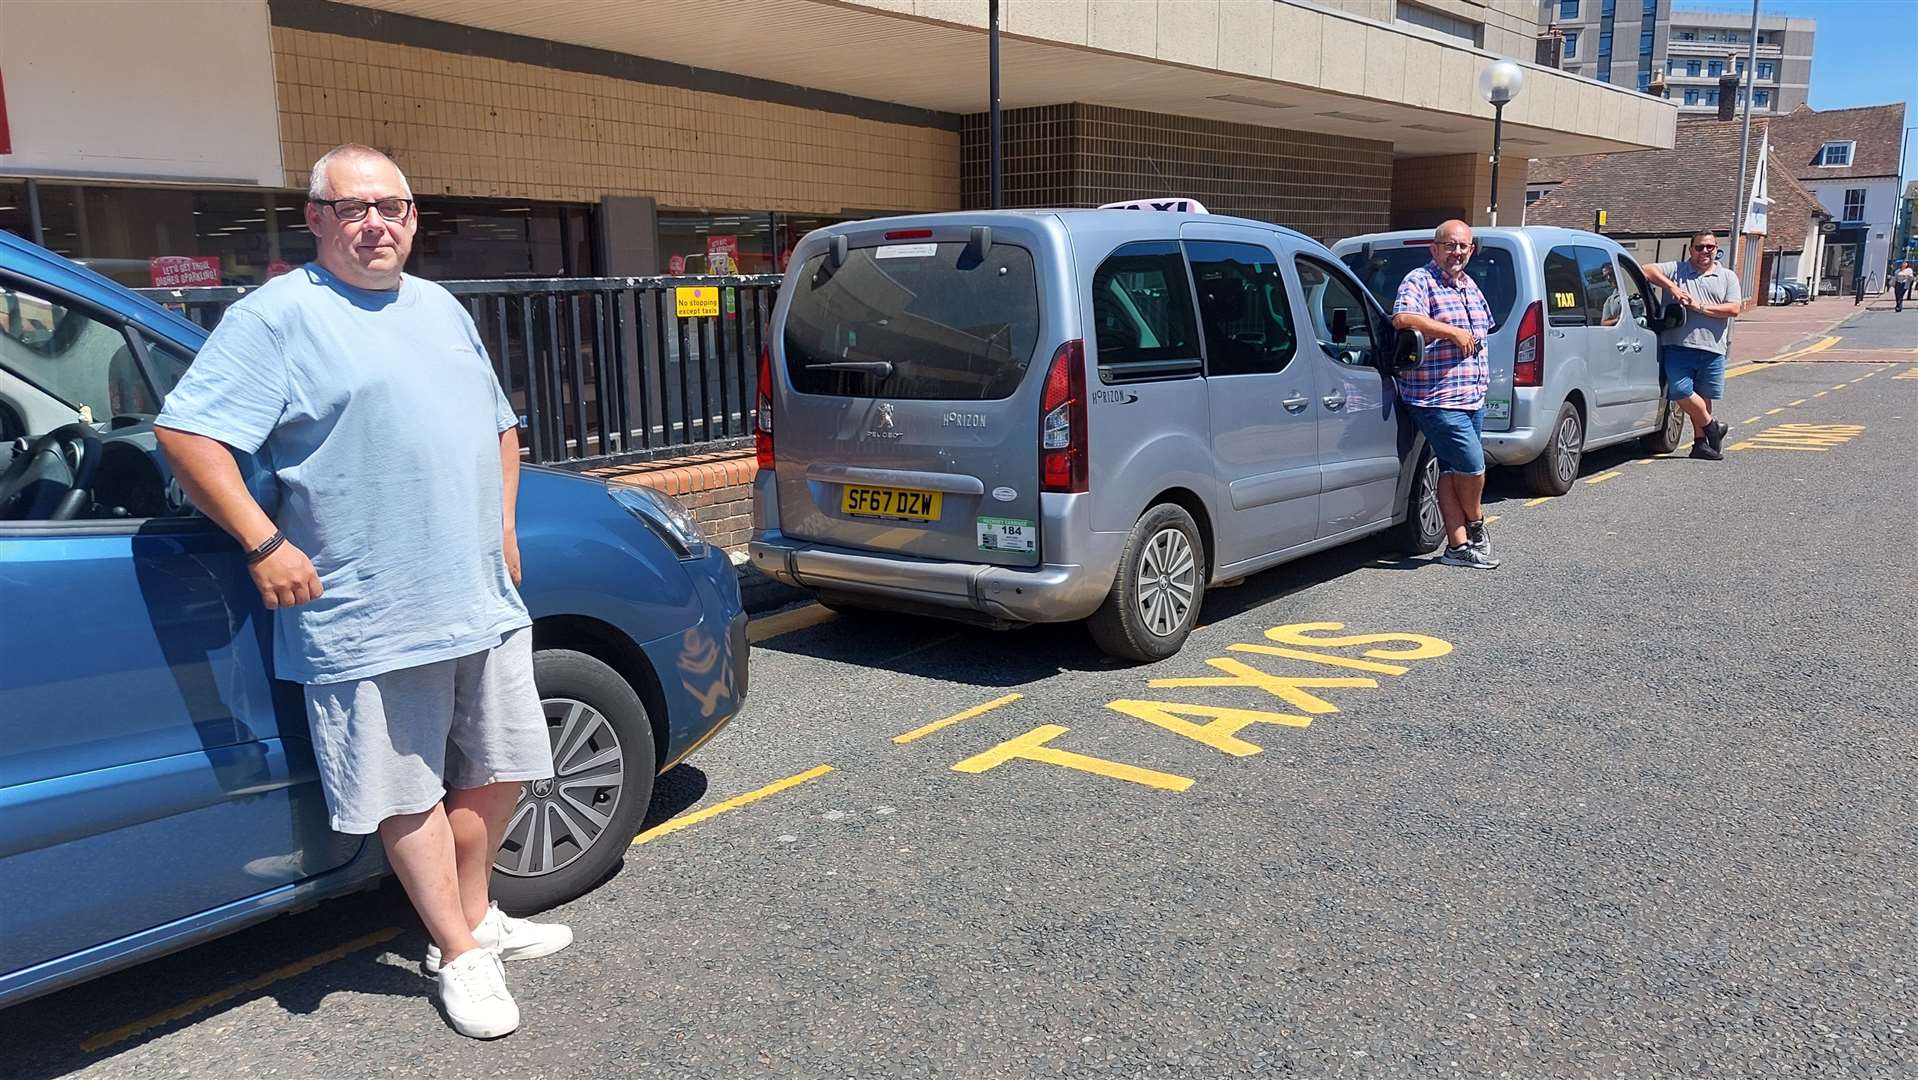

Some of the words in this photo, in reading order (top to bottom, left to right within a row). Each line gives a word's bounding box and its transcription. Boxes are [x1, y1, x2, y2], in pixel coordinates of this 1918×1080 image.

[1103, 201, 1188, 212] XI
[180, 262, 191, 273] GET
[678, 299, 688, 307] No
[689, 299, 717, 309] stopping
[1555, 292, 1575, 308] TAXI
[679, 307, 700, 316] except
[701, 307, 717, 315] taxis
[1092, 390, 1124, 405] HORIZON
[943, 412, 986, 427] HORIZON
[848, 489, 891, 513] SF67
[896, 491, 933, 515] DZW
[1001, 525, 1022, 536] 184
[949, 621, 1454, 792] TAXIS
